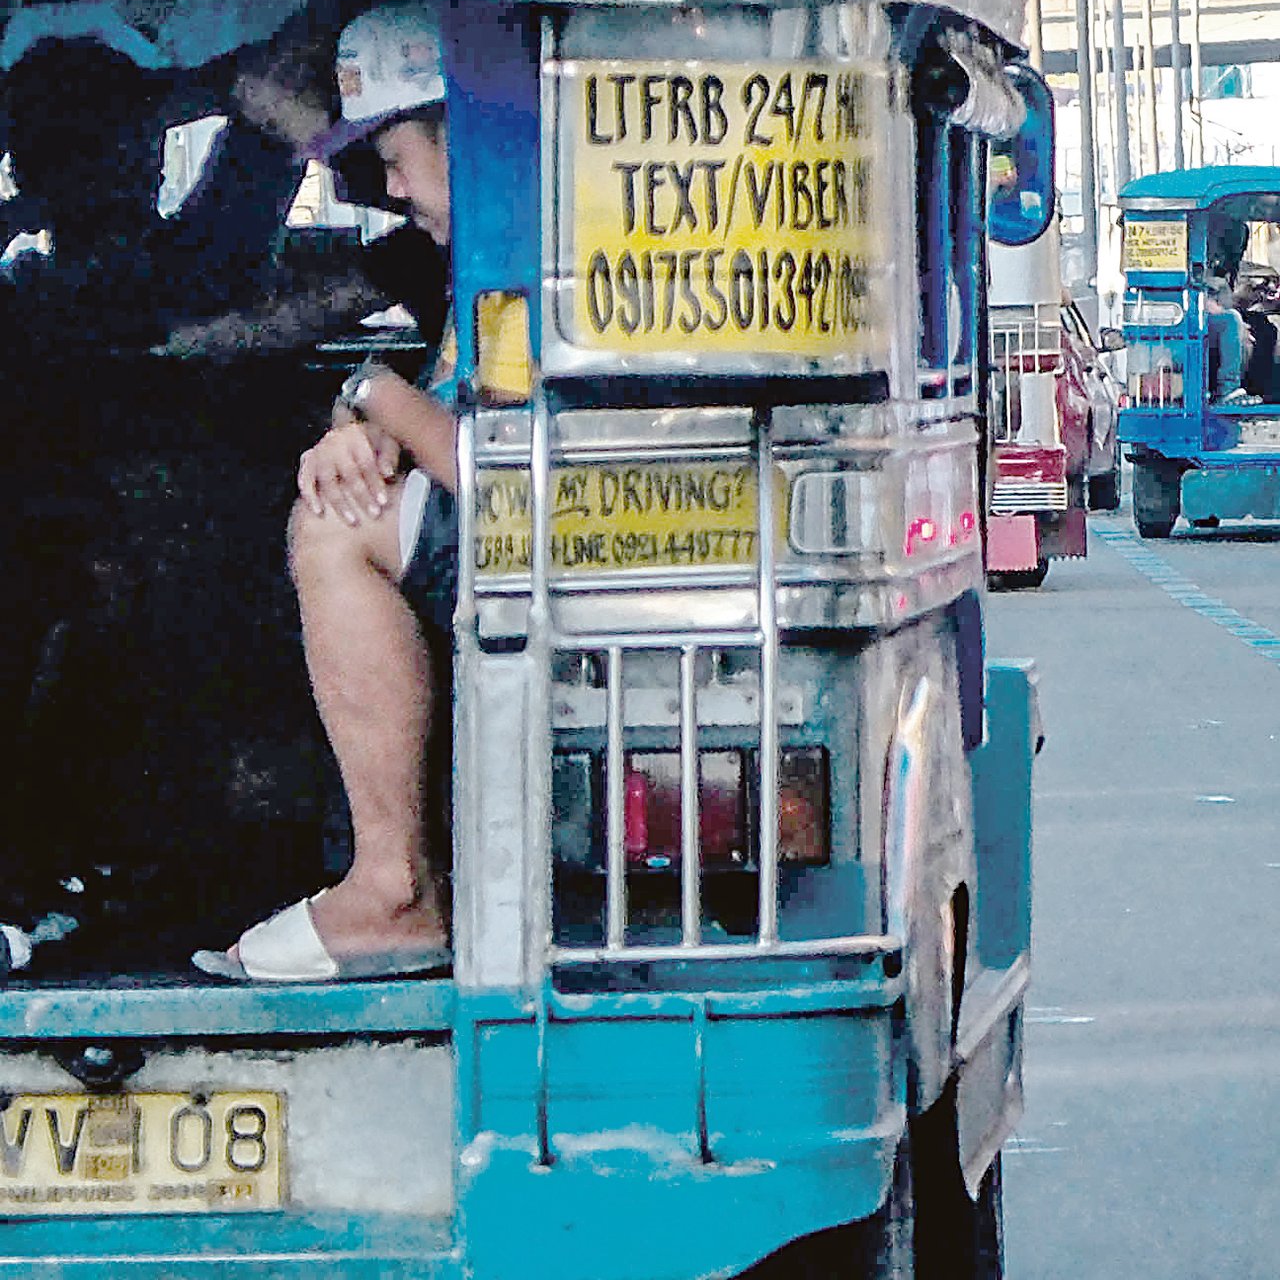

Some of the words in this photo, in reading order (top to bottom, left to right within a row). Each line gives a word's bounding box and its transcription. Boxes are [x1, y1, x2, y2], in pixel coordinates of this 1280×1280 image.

[585, 72, 728, 146] LTFRB
[739, 71, 829, 152] 24/7
[612, 154, 848, 240] TEXT/VIBER
[599, 469, 745, 517] DRIVING?
